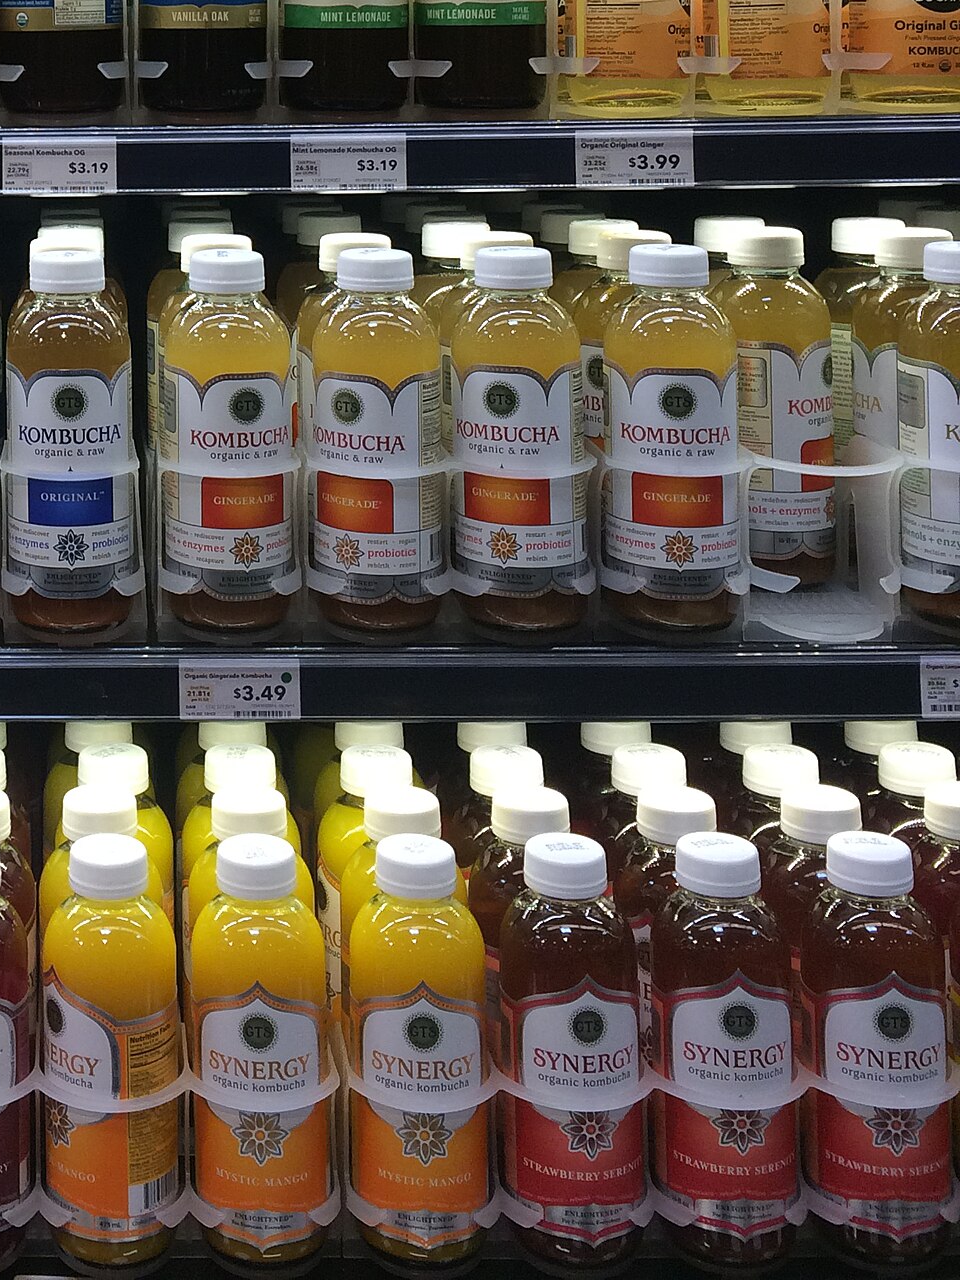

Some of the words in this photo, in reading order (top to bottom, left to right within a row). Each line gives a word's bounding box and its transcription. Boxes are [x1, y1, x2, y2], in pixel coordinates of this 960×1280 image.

[171, 11, 204, 22] VANILLA
[207, 11, 229, 22] OAK
[320, 12, 344, 23] MINT
[347, 12, 391, 23] LEMONADE
[610, 141, 637, 149] Original
[639, 141, 664, 149] Ginger
[69, 162, 108, 174] $3.19
[357, 160, 397, 171] $3.19
[628, 154, 680, 169] $3.99
[18, 425, 119, 445] KOMBUCHA
[620, 423, 731, 445] KOMBUCHA
[639, 446, 680, 460] organic
[684, 446, 692, 456] &
[695, 447, 715, 457] raw
[643, 492, 711, 504] GINGERADE
[525, 539, 571, 552] probiotics
[233, 685, 286, 701] $3.49
[683, 1041, 785, 1070] SYNERGY
[209, 1051, 309, 1081] SYNERGY
[688, 1064, 731, 1082] organic
[735, 1068, 784, 1081] kombucha
[213, 1074, 249, 1090] organic
[252, 1078, 306, 1092] kombucha
[673, 1150, 751, 1176] STRAWBERRY
[216, 1168, 261, 1185] MYSTIC
[265, 1174, 308, 1187] MANGO
